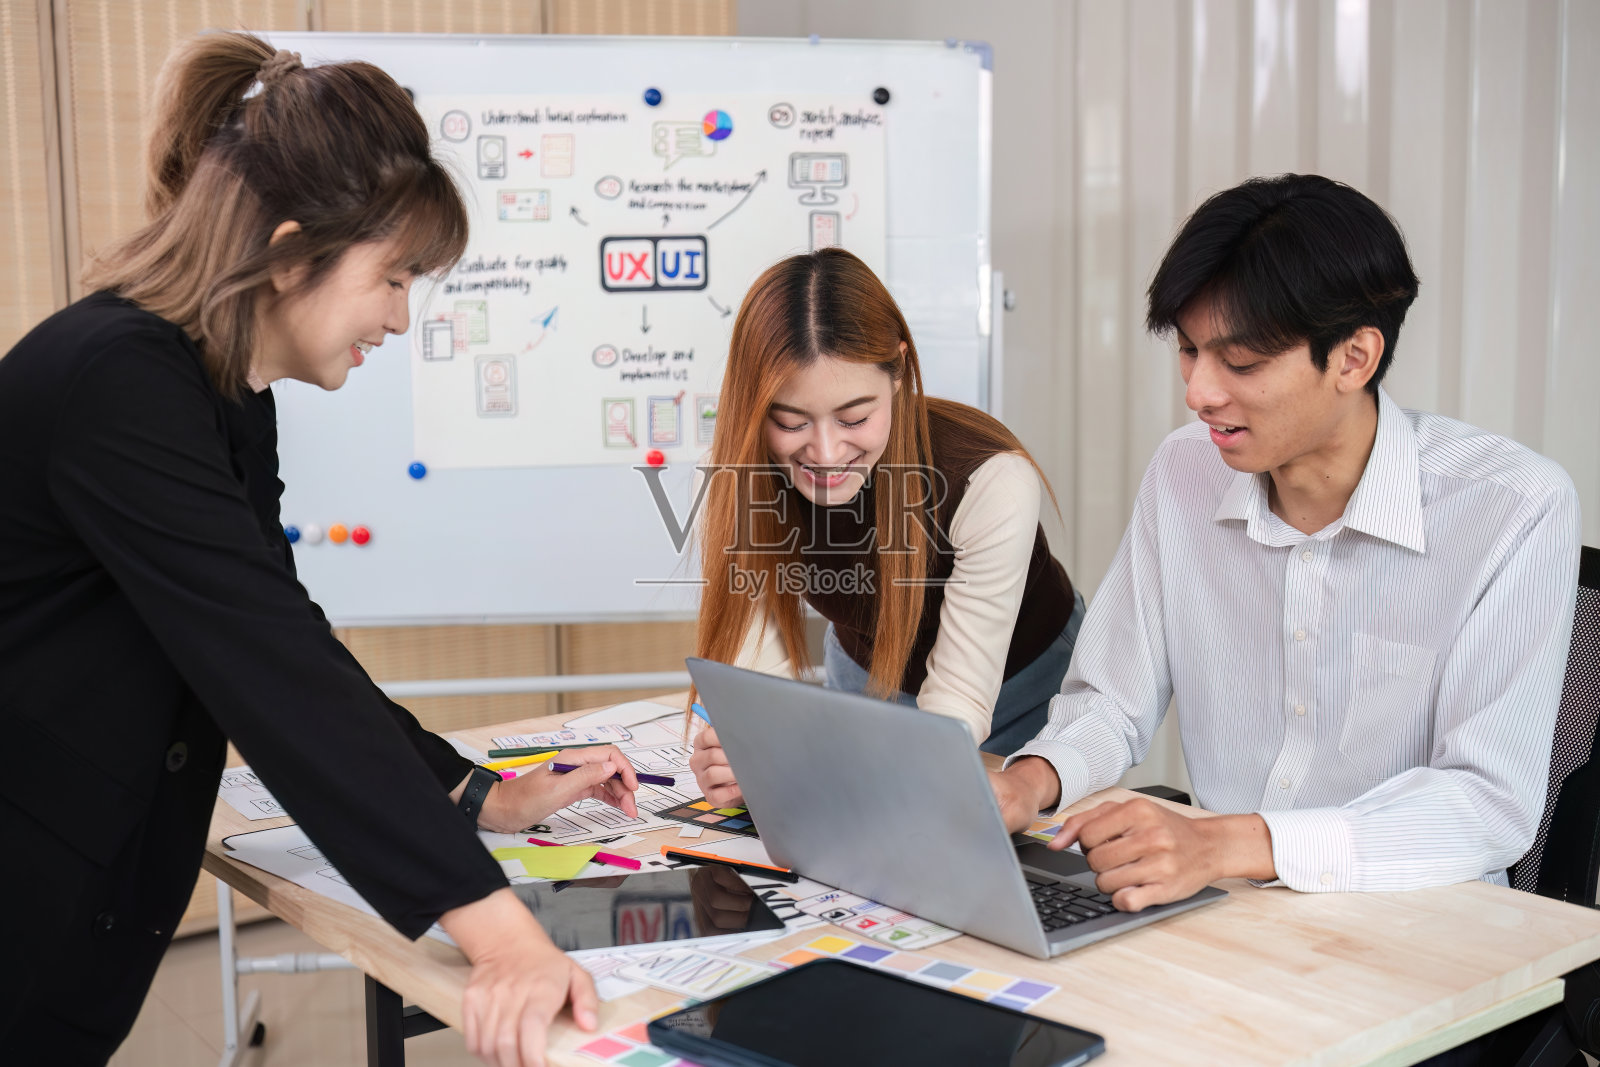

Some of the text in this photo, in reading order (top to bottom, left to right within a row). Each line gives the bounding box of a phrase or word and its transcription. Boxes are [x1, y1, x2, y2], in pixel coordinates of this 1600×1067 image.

[677, 176, 692, 192] the
[515, 254, 531, 270] for
[607, 250, 701, 281] UX UI
[672, 347, 695, 362] and
